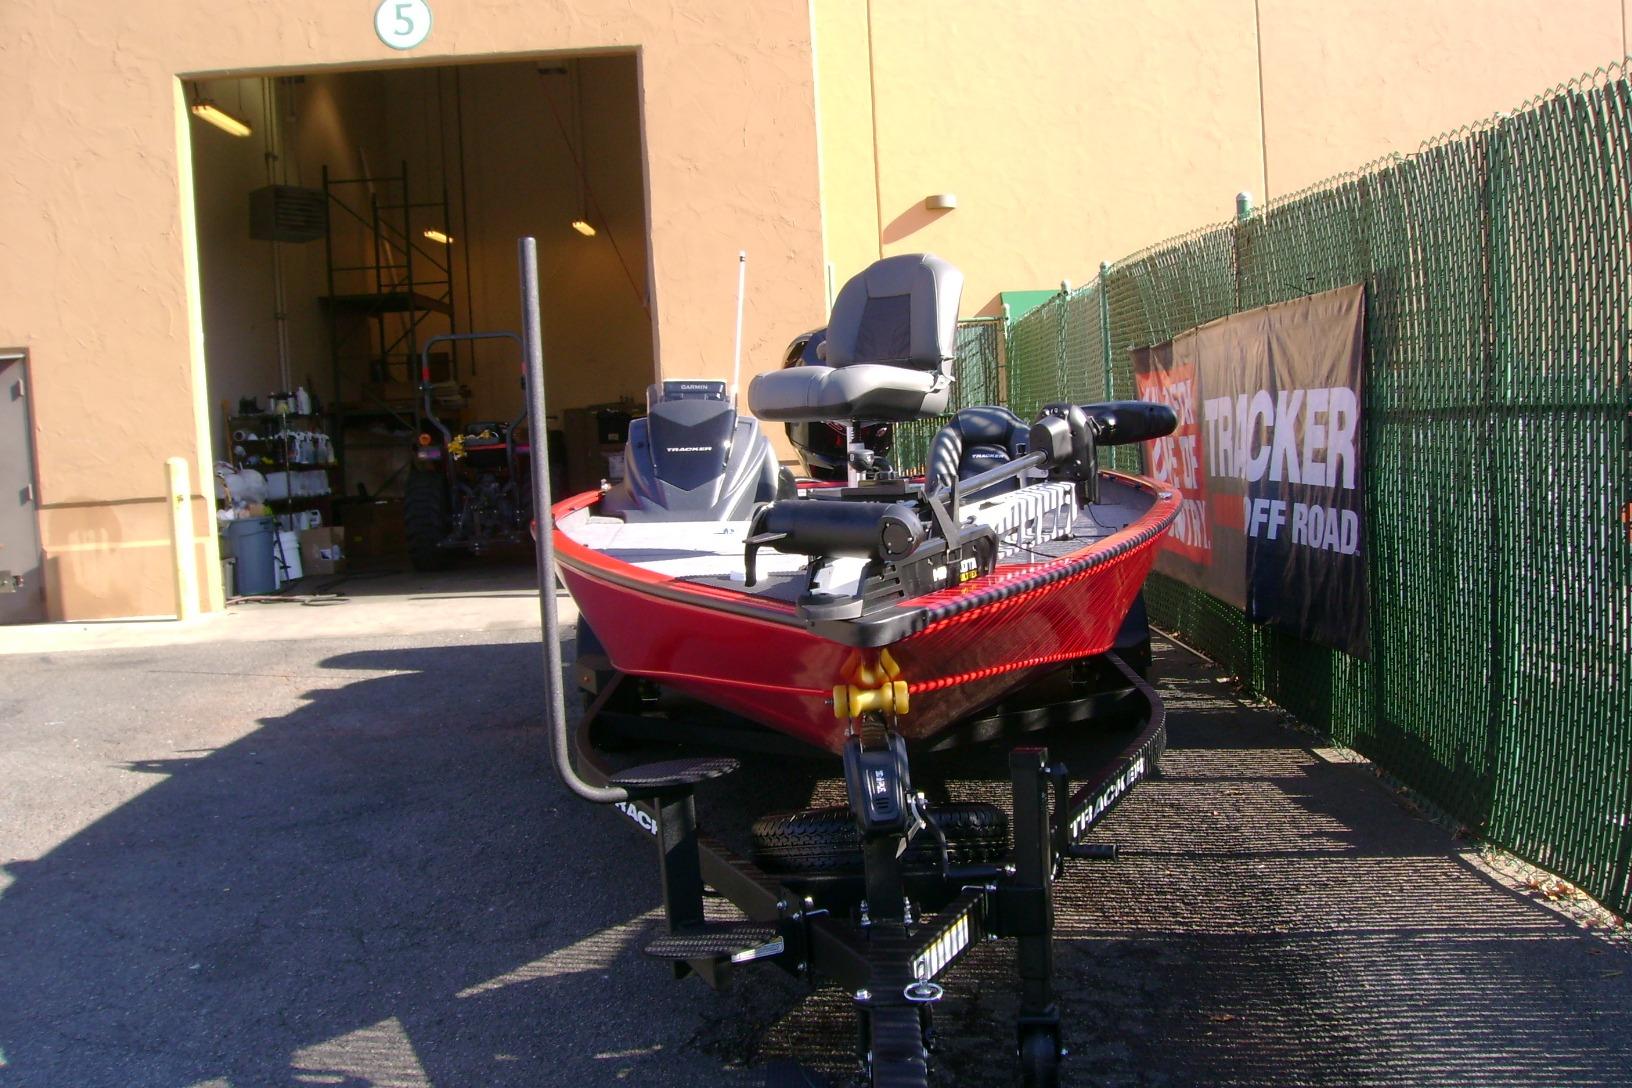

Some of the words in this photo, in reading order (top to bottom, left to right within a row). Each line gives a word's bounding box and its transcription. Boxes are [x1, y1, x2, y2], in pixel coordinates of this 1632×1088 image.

[393, 3, 414, 36] 5
[1204, 387, 1358, 489] TRACKER
[1291, 502, 1359, 555] ROAD
[1069, 757, 1145, 838] TRACKER
